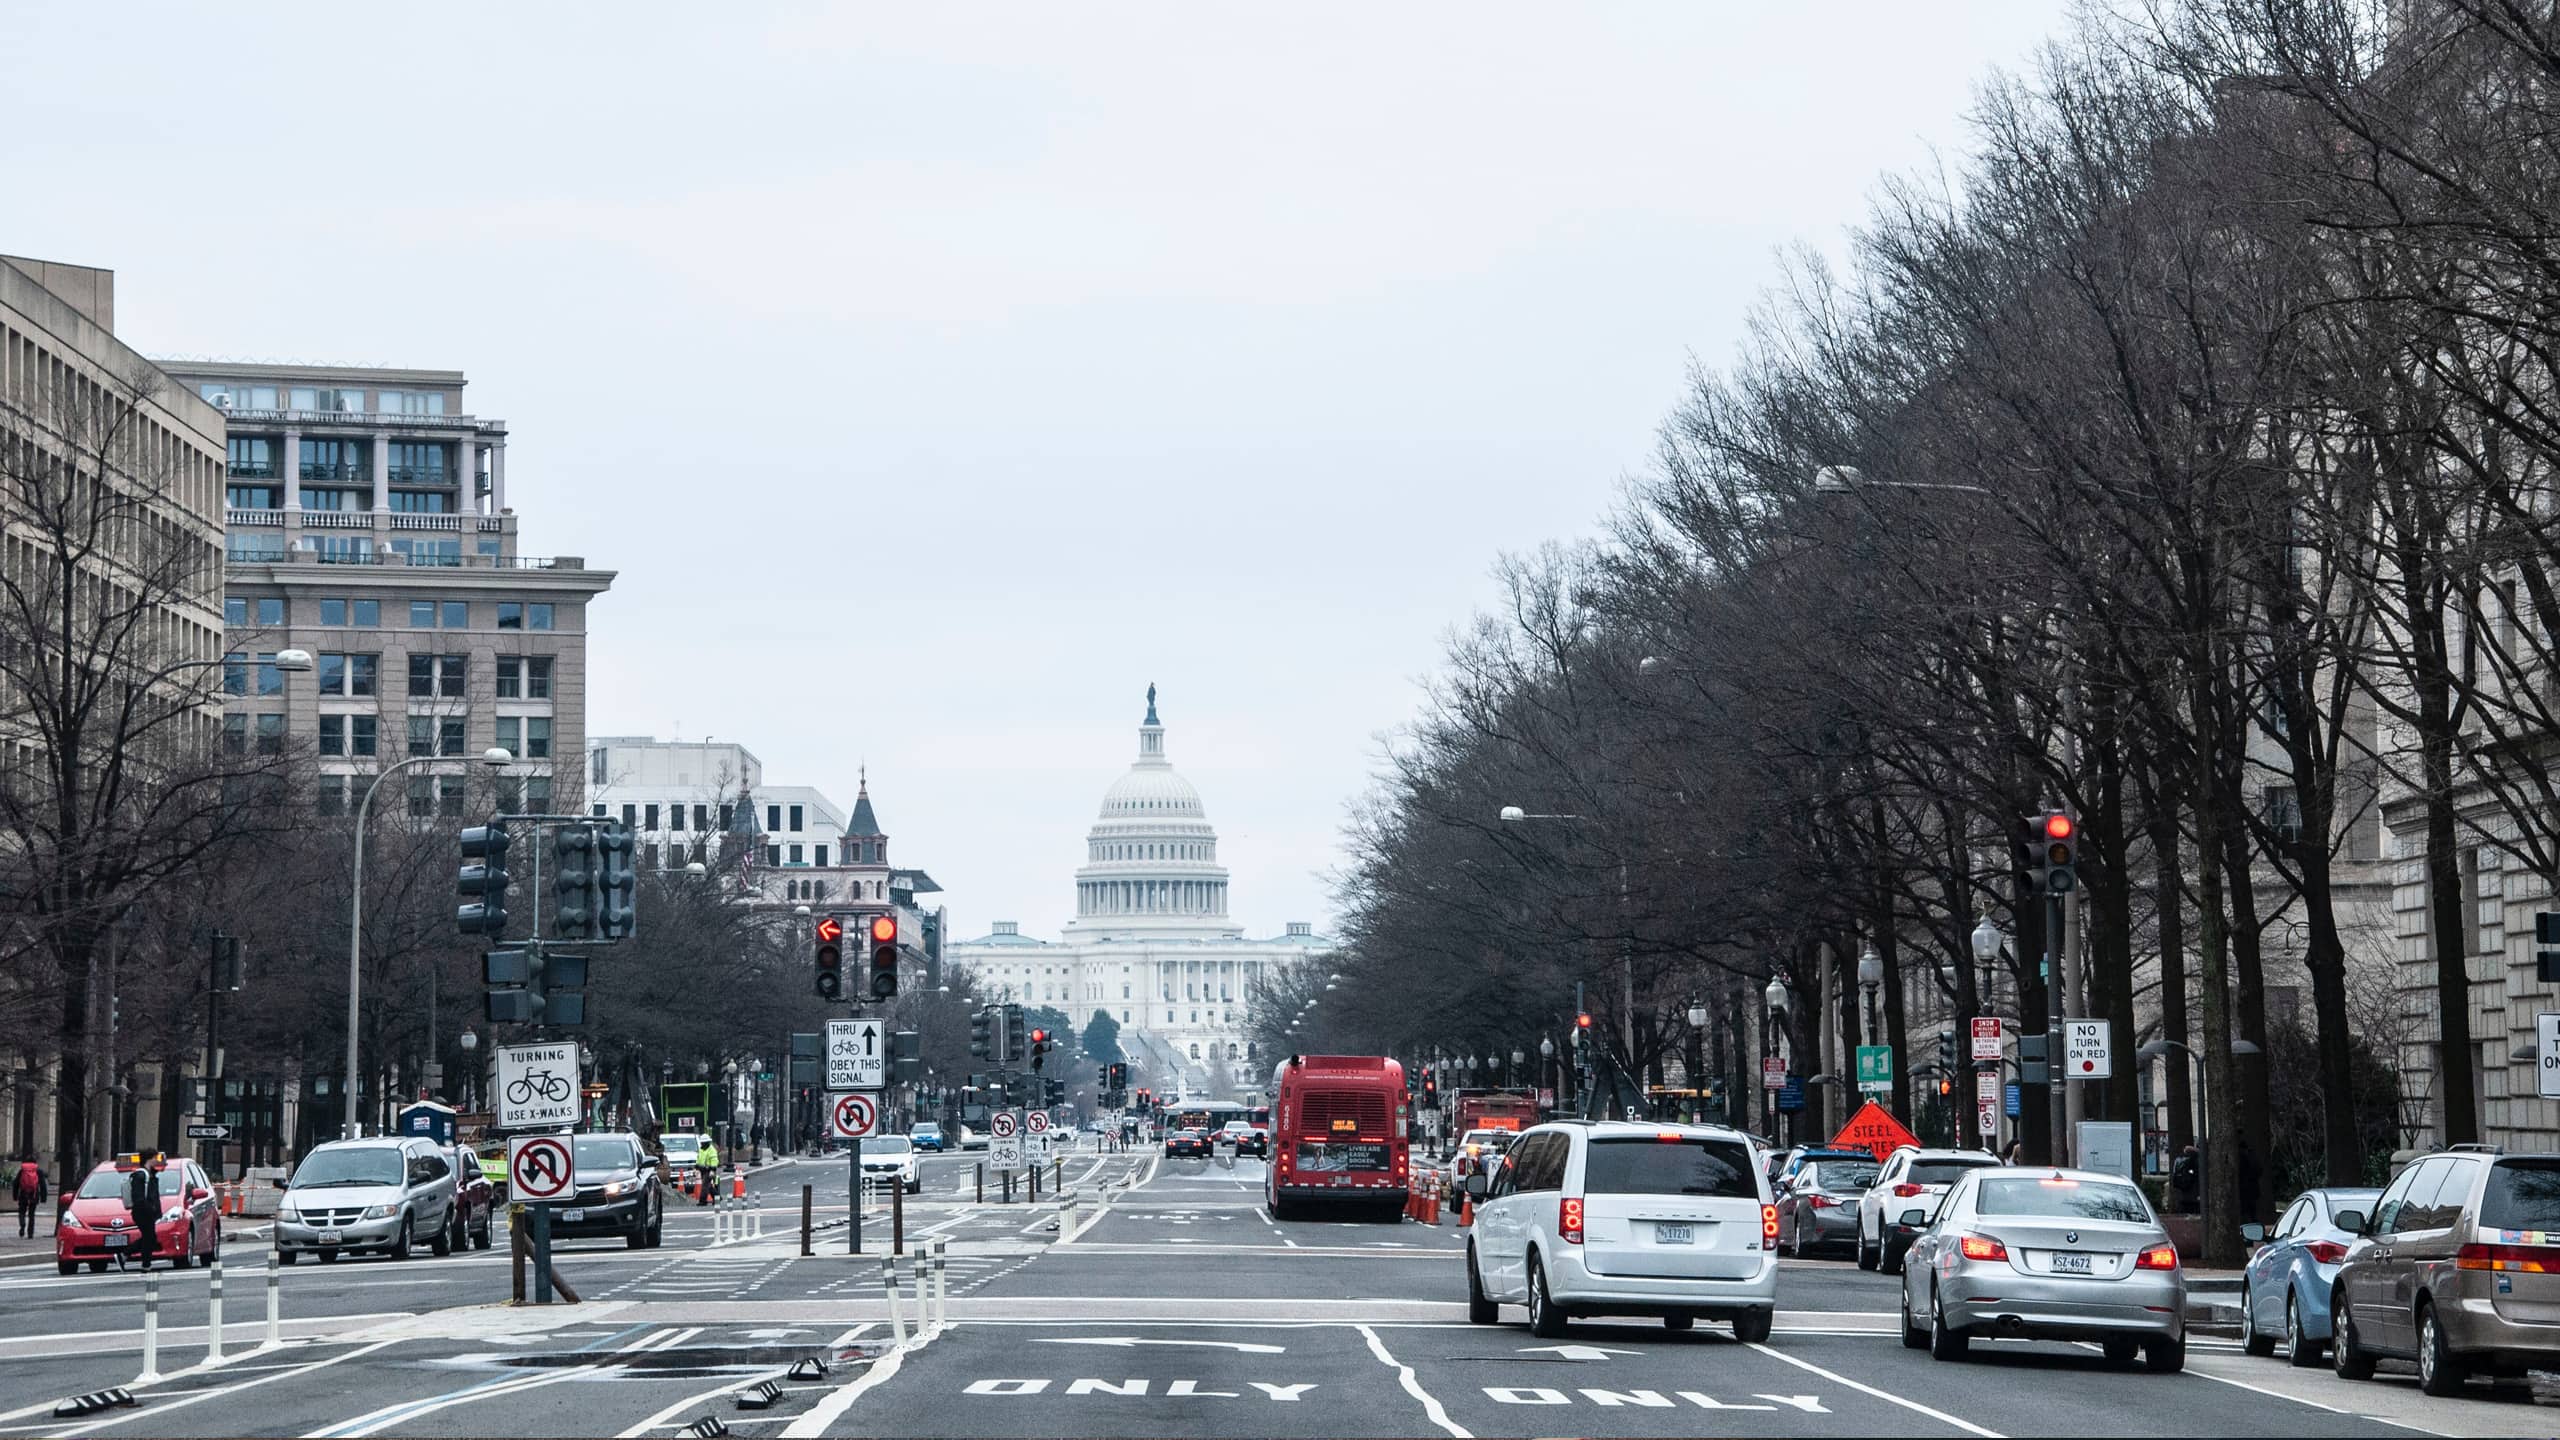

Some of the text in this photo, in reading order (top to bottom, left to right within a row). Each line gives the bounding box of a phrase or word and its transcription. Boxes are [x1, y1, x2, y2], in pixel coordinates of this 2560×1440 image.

[831, 1024, 856, 1035] THRU
[2077, 1025, 2096, 1036] NO
[2075, 1038, 2100, 1048] TURN
[510, 1050, 565, 1063] TURNING
[2070, 1050, 2105, 1058] ON RED
[831, 1059, 881, 1071] OBEY THIS
[831, 1072, 864, 1083] SIGNAL
[507, 1106, 573, 1121] USE X-WALKS
[1854, 1124, 1892, 1137] STEEL
[962, 1378, 1320, 1401] ONLY
[1481, 1387, 1832, 1413] ONLY
